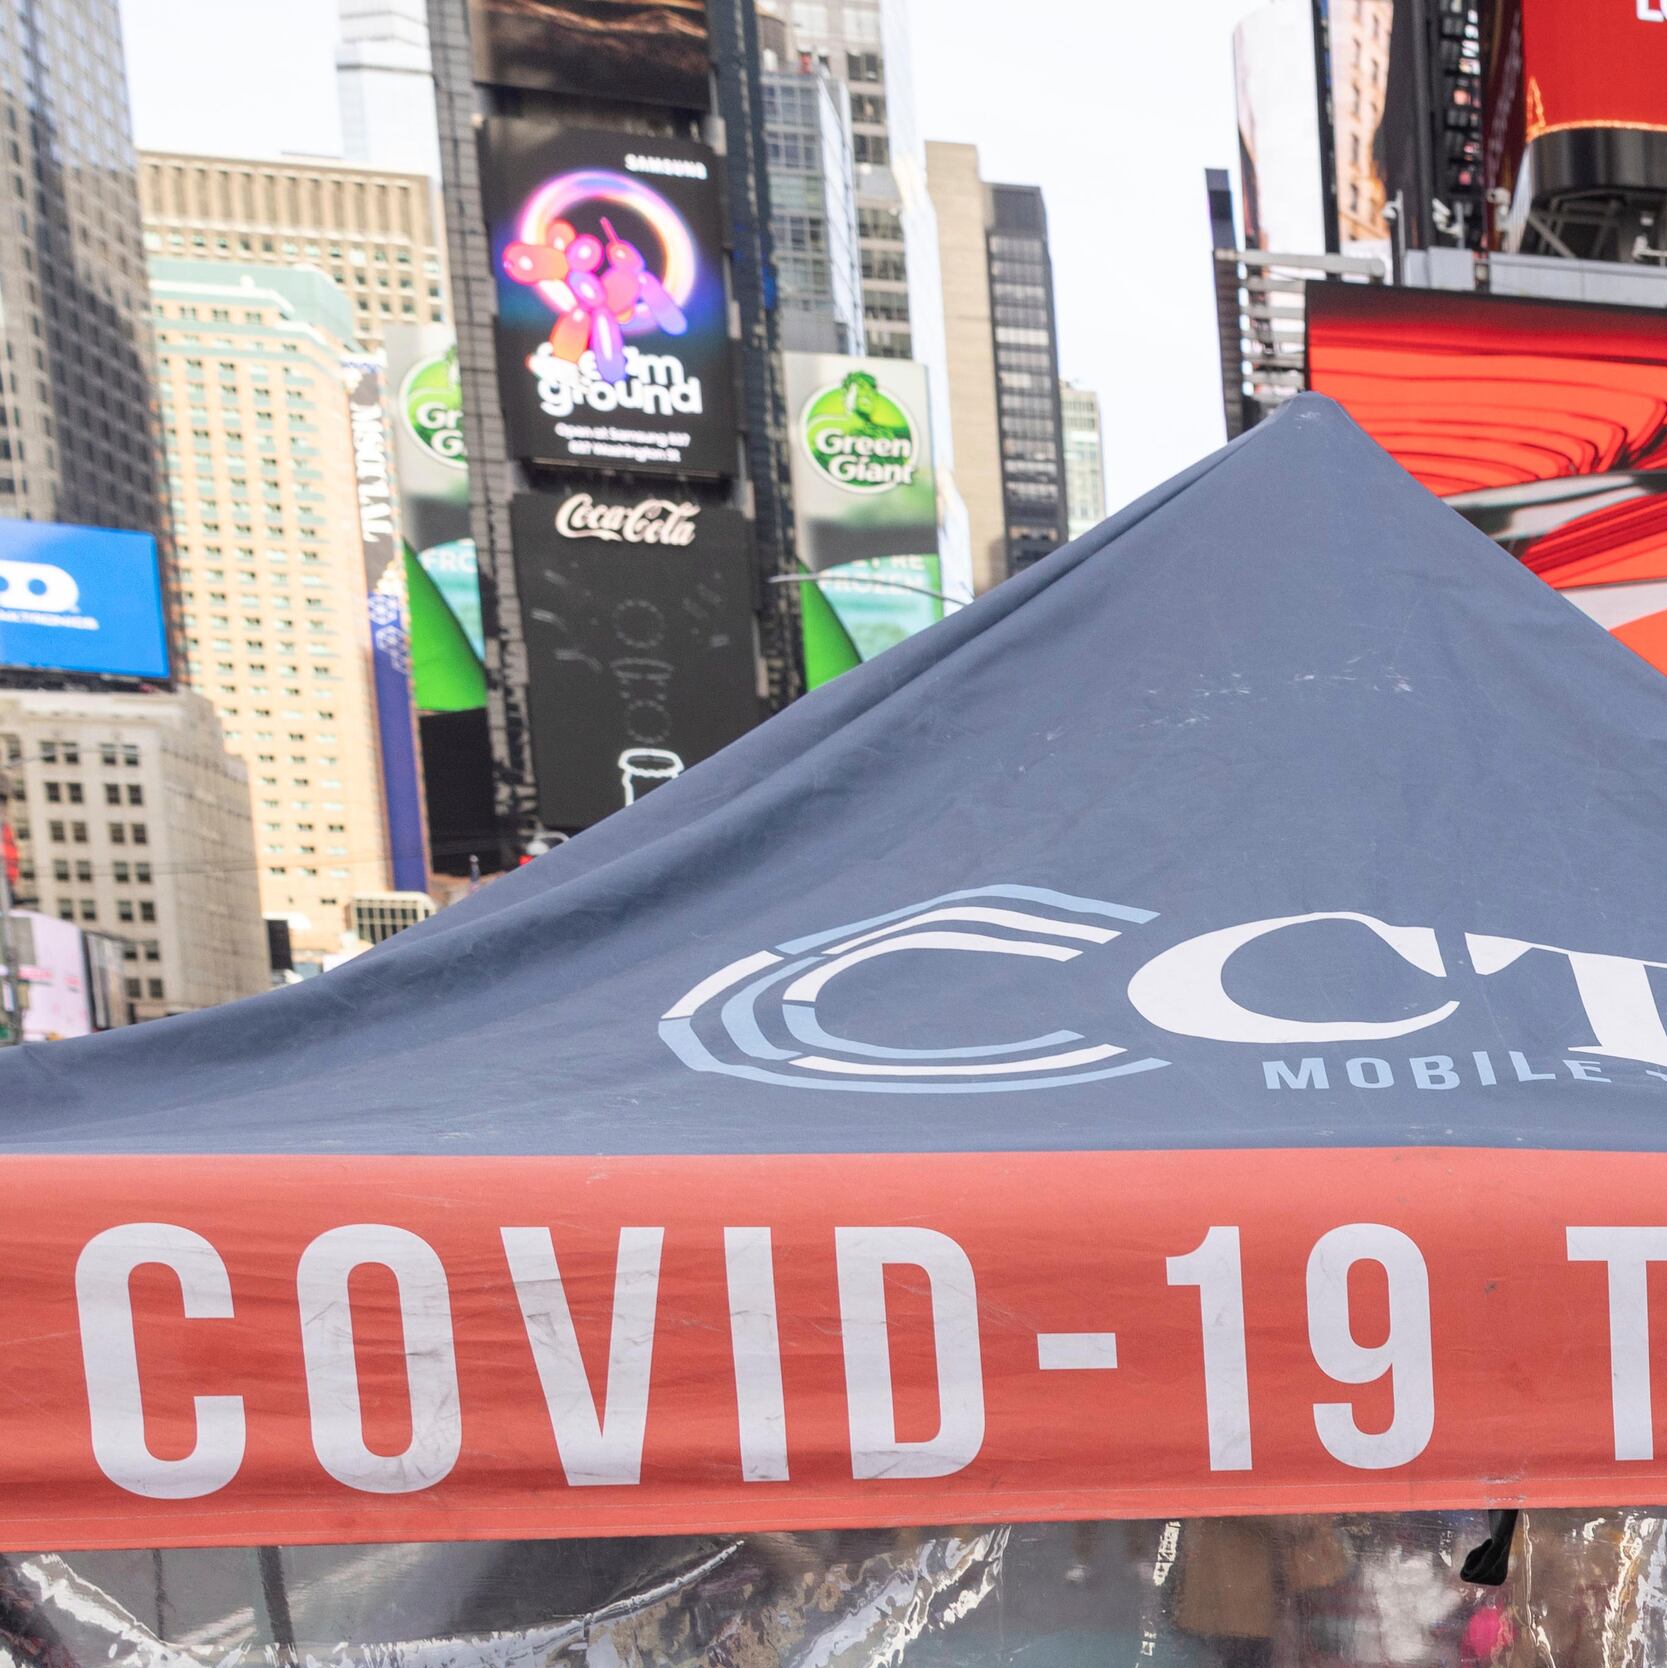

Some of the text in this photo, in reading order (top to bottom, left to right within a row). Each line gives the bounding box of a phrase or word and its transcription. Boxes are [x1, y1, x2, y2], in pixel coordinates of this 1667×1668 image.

[624, 153, 708, 180] SAMSUNG
[538, 377, 703, 418] ground
[815, 428, 912, 458] Green
[828, 455, 914, 485] Giant
[1262, 1050, 1611, 1090] MOBILE
[74, 1221, 1436, 1500] COVID-19
